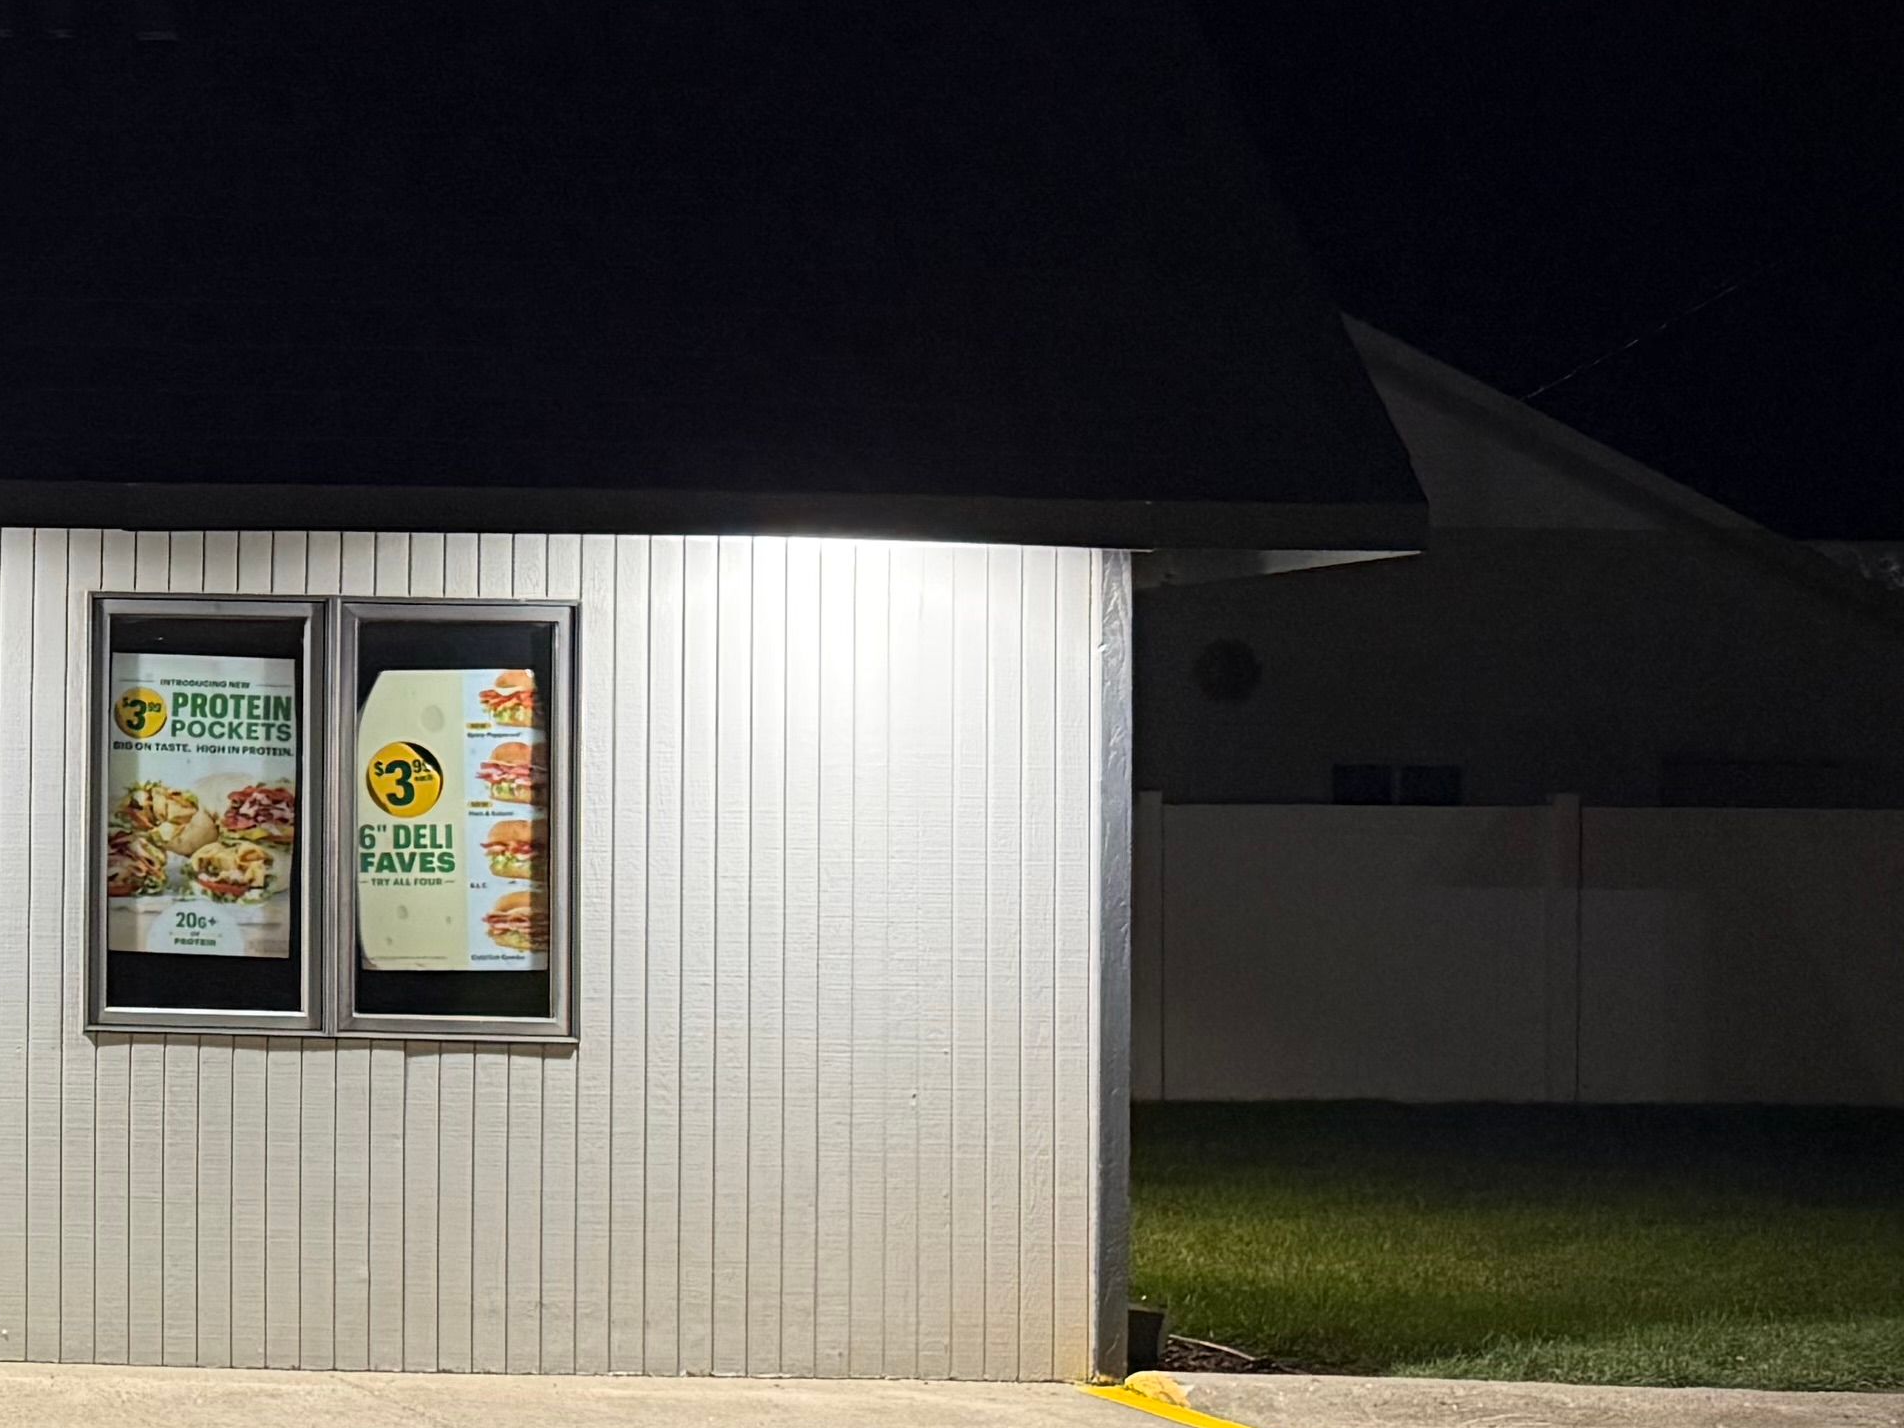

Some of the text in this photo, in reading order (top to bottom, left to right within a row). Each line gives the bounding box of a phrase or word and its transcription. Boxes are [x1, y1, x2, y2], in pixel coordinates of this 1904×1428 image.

[160, 679, 250, 689] INTRODUCING NEW
[171, 692, 292, 721] PROTEIN
[171, 719, 292, 742] POCKETS
[113, 741, 294, 757] BIG ON TASTE. HIGH IN PROTEIN.
[358, 824, 453, 850] 6" DELI
[360, 851, 456, 874] FAVES
[371, 877, 442, 886] TRY ALL FOUR
[173, 937, 217, 947] PROTEIN
